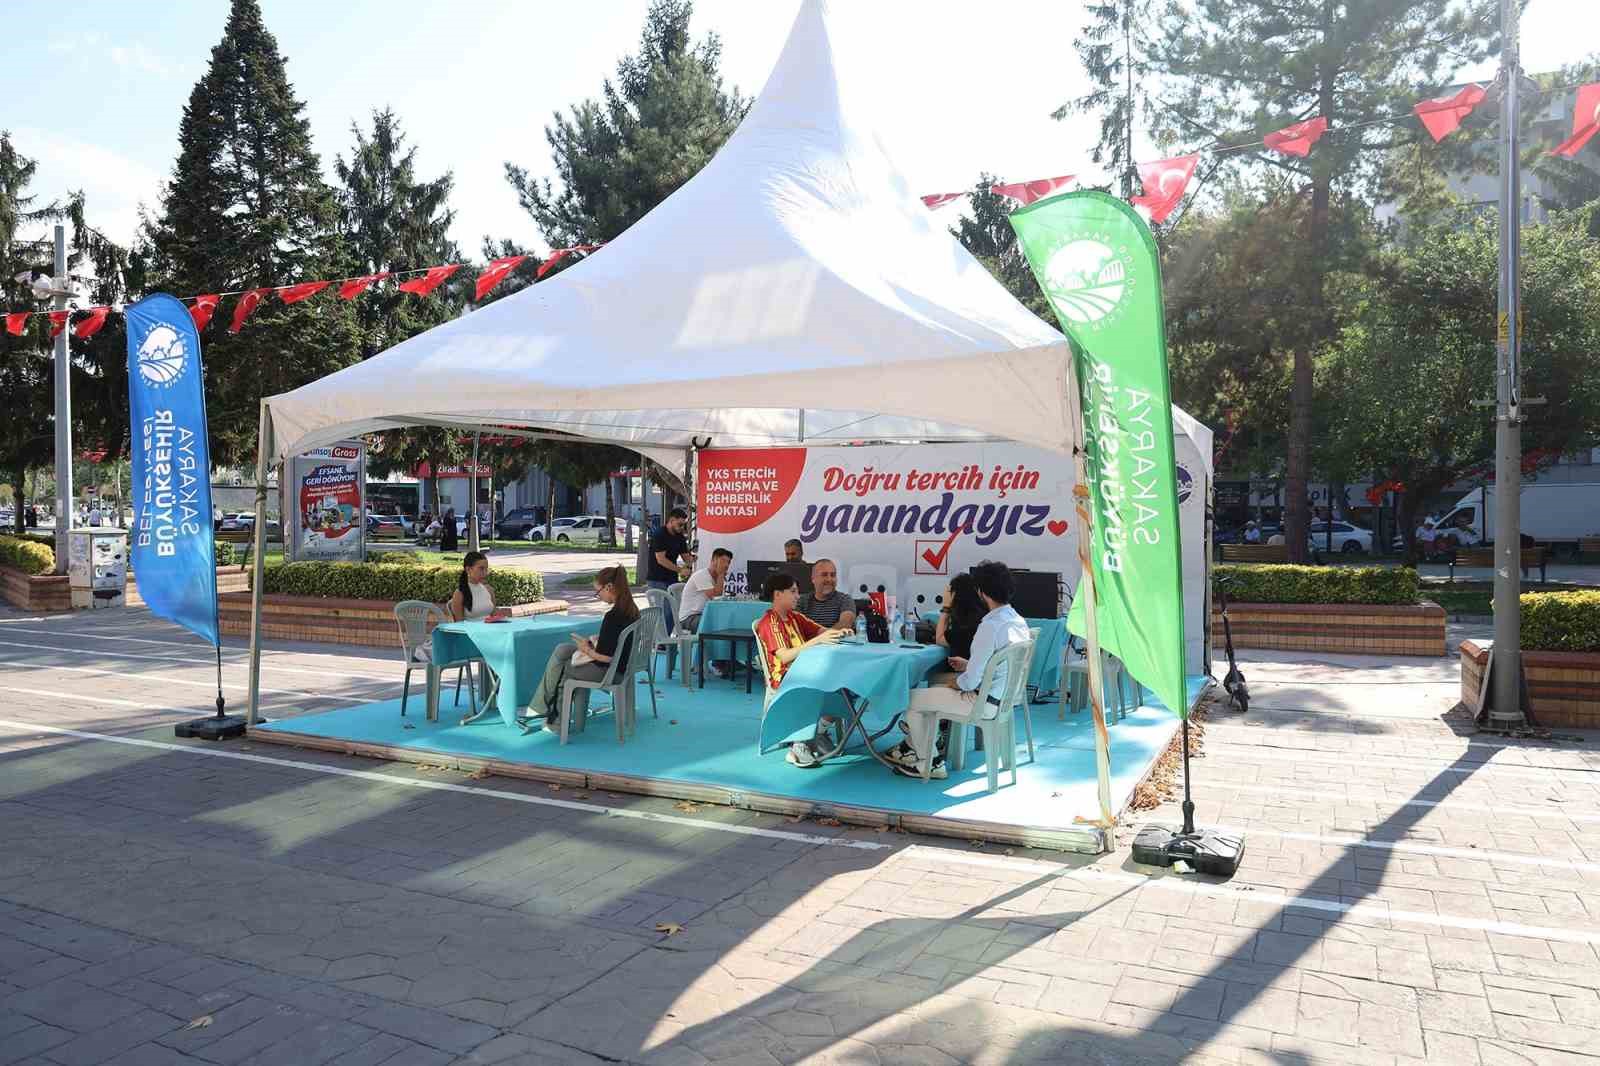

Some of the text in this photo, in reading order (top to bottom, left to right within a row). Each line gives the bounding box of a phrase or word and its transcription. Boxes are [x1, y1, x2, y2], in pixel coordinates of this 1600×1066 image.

[334, 448, 356, 457] Gross
[707, 466, 776, 479] YKS TERCİH
[706, 480, 779, 493] DANIŞMA VE
[823, 464, 1040, 498] Doğru tercih için
[706, 491, 771, 504] REHBERLİK
[705, 506, 757, 516] NOKTASI
[800, 492, 1050, 546] yanındayız
